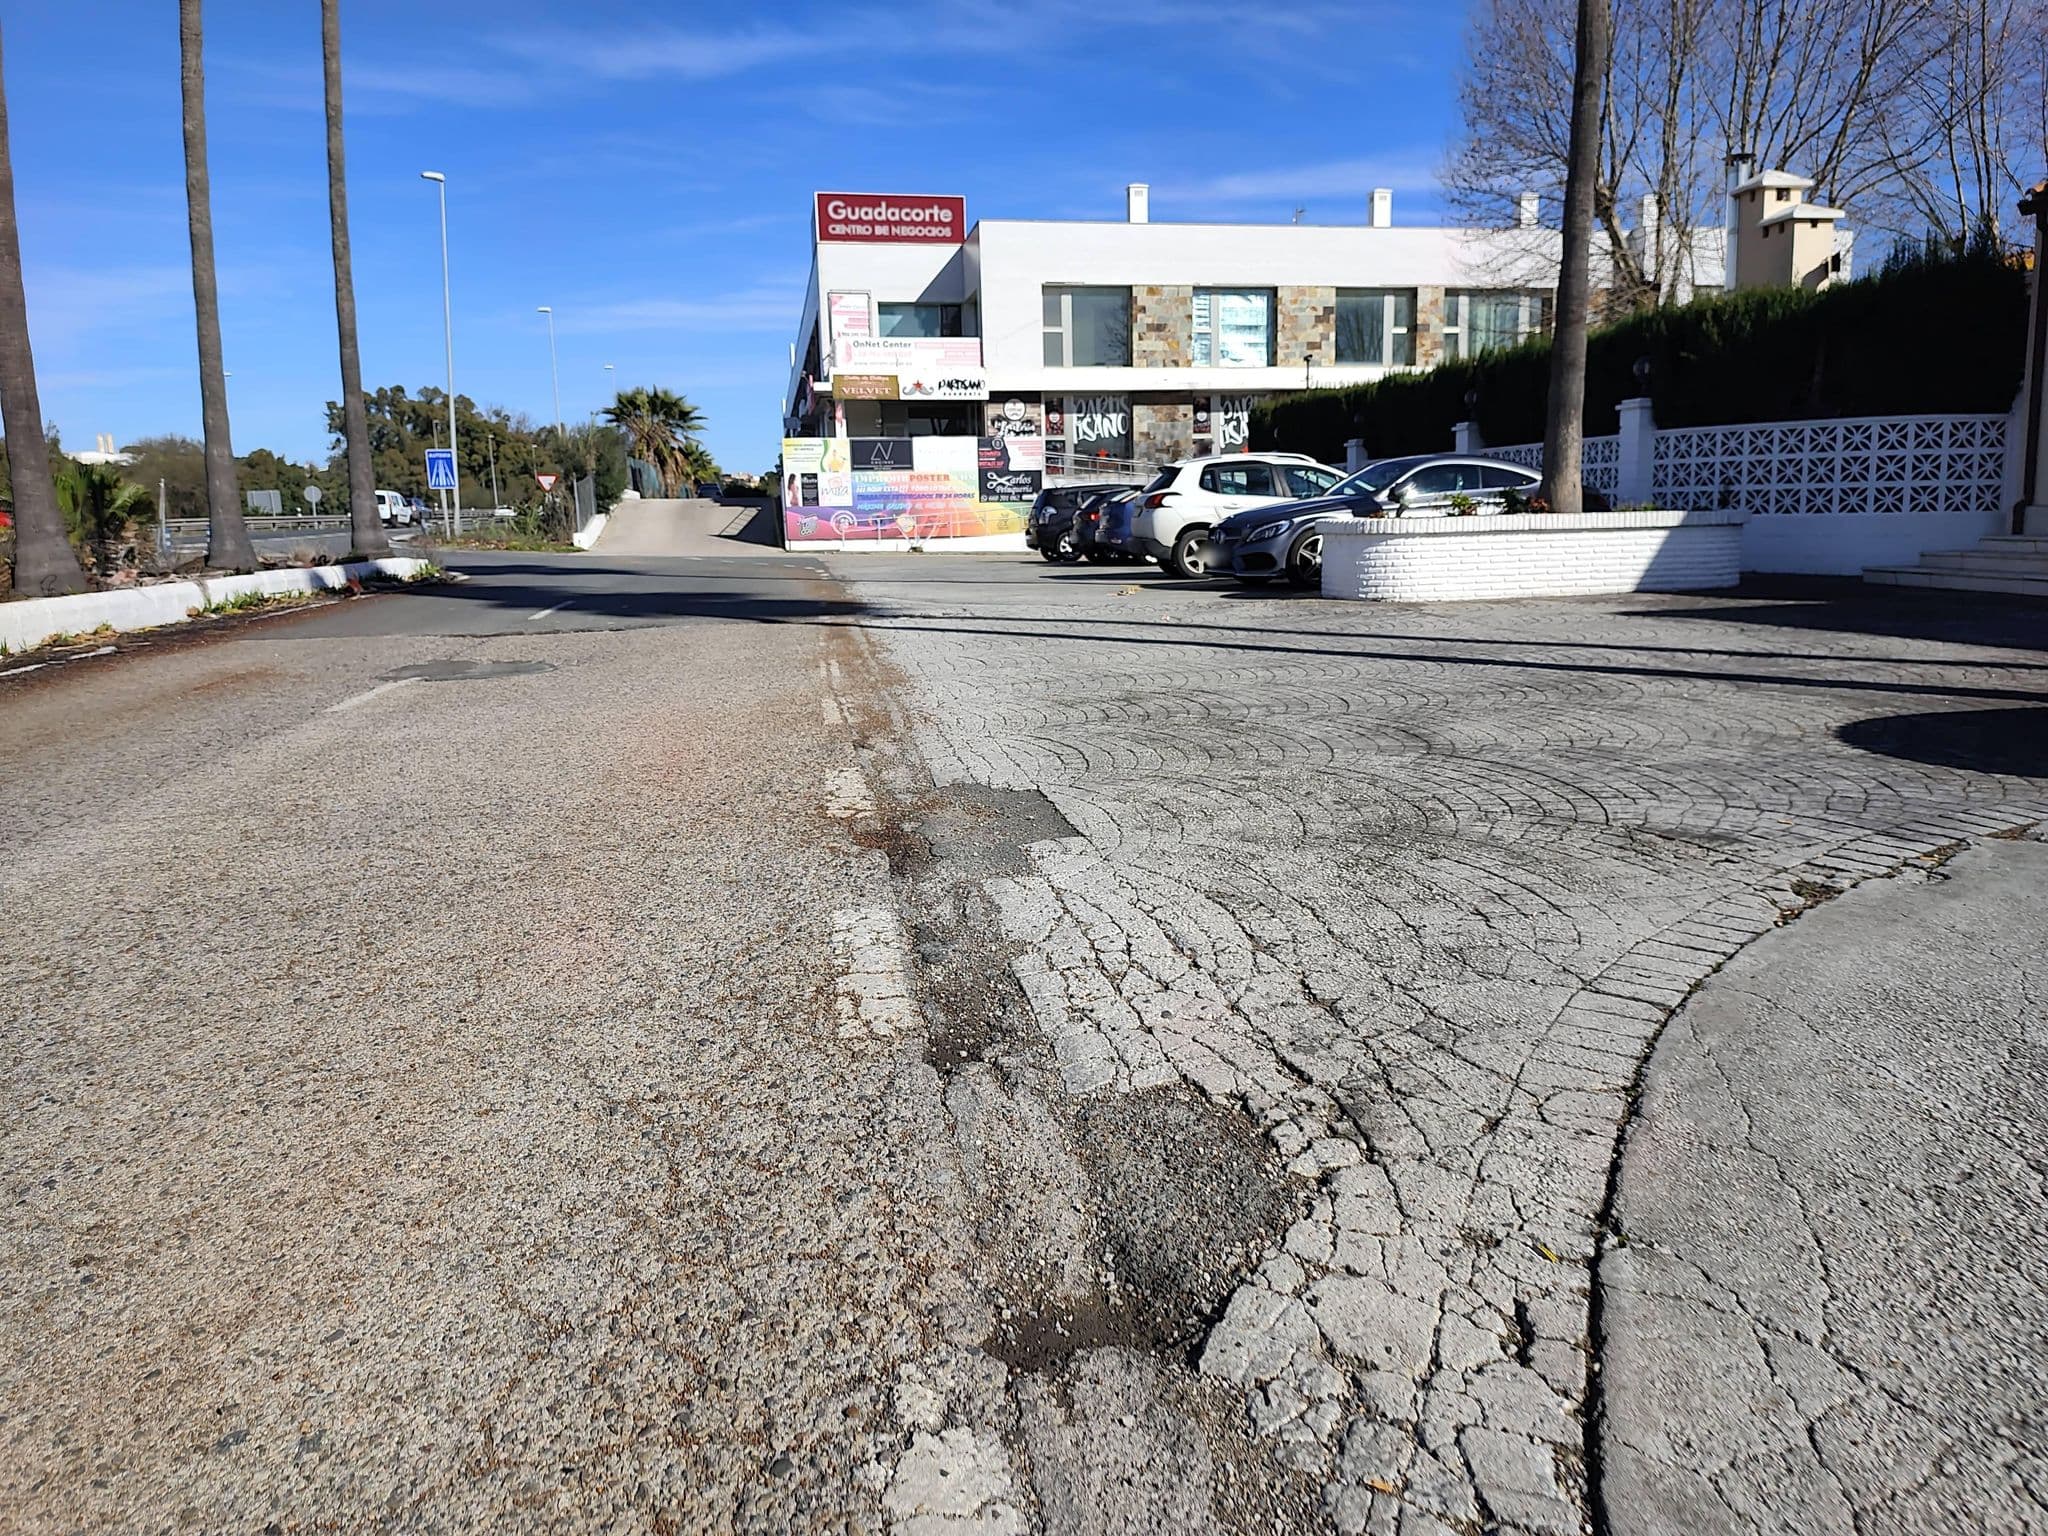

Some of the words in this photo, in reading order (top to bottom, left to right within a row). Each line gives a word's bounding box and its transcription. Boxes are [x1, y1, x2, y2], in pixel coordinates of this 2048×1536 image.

[827, 200, 953, 222] Guadacorte
[828, 224, 873, 236] CENTRO
[874, 225, 890, 236] DE
[891, 226, 952, 237] NEGOCIOS
[852, 340, 880, 348] OnNet
[882, 340, 912, 348] Center
[841, 386, 892, 396] VELVET
